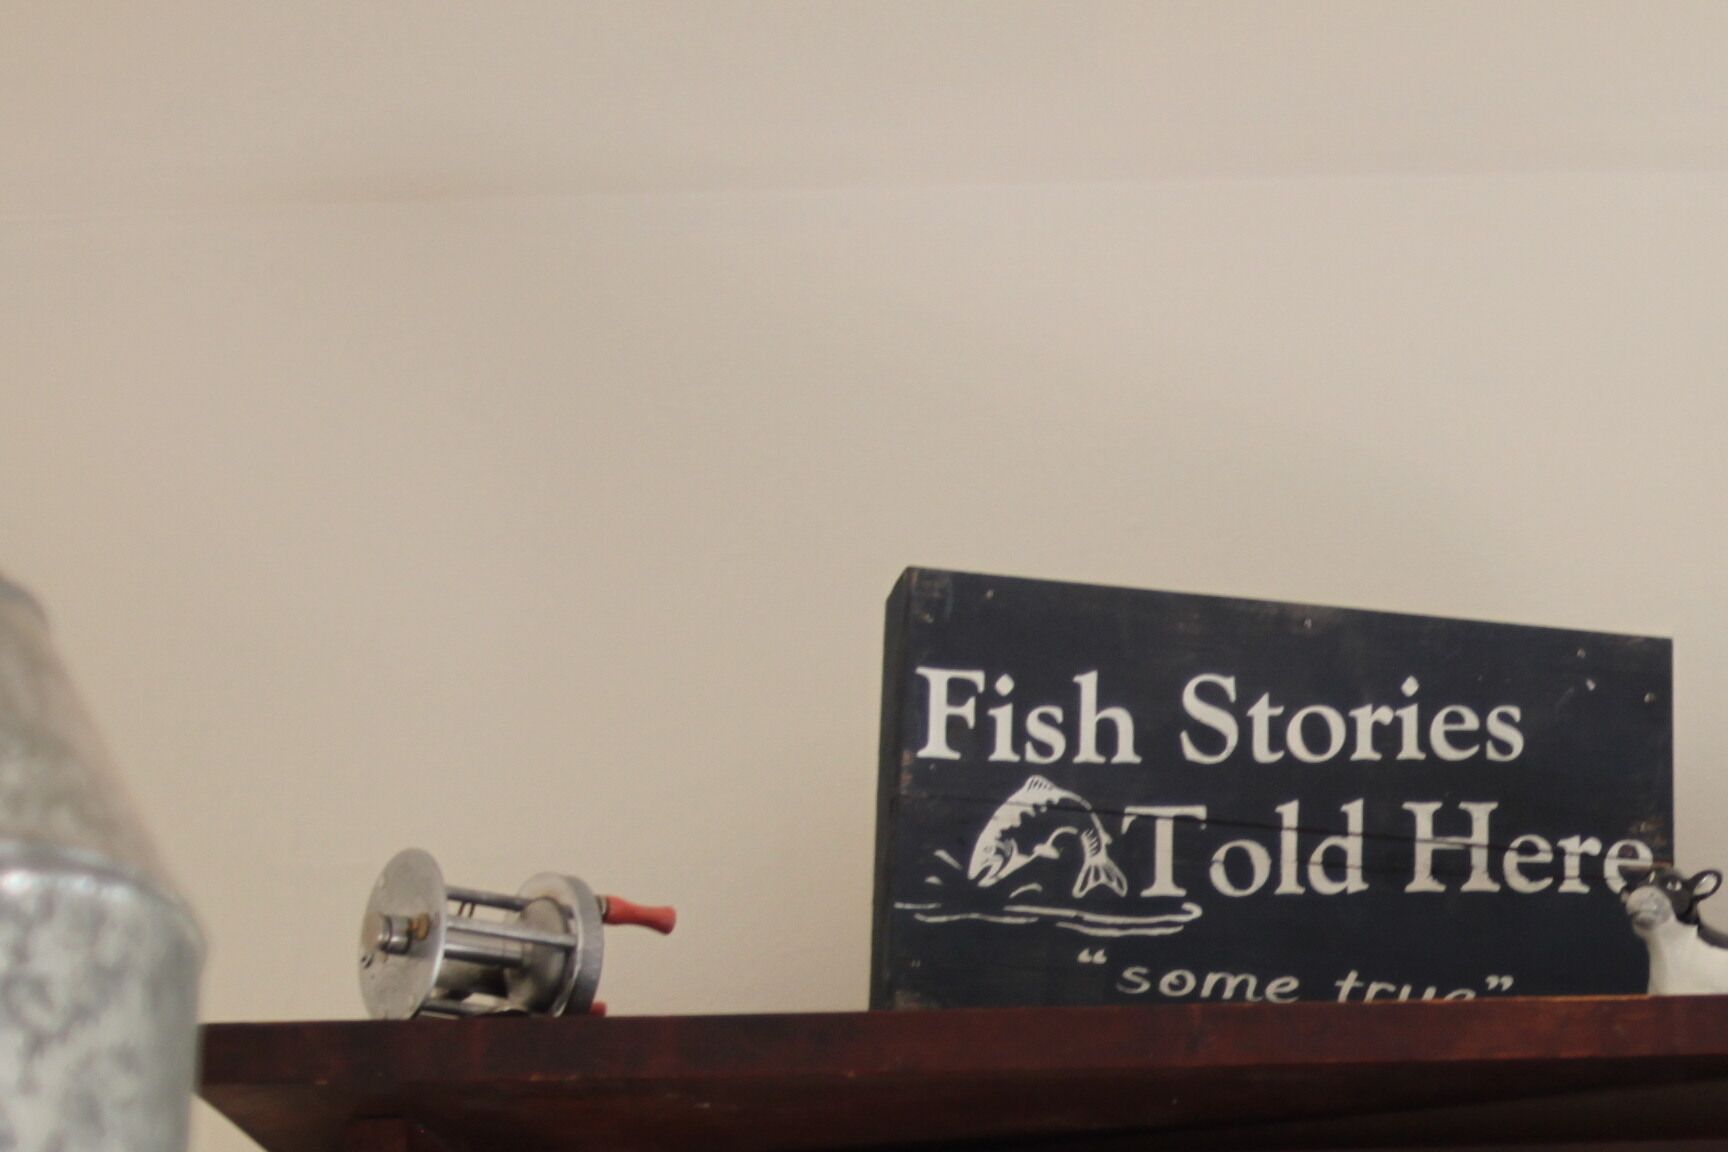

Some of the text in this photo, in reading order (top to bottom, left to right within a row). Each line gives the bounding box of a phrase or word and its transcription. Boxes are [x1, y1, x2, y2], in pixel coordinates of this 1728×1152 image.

[915, 666, 1525, 765] Fish Stories
[1120, 799, 1654, 899] Told Here
